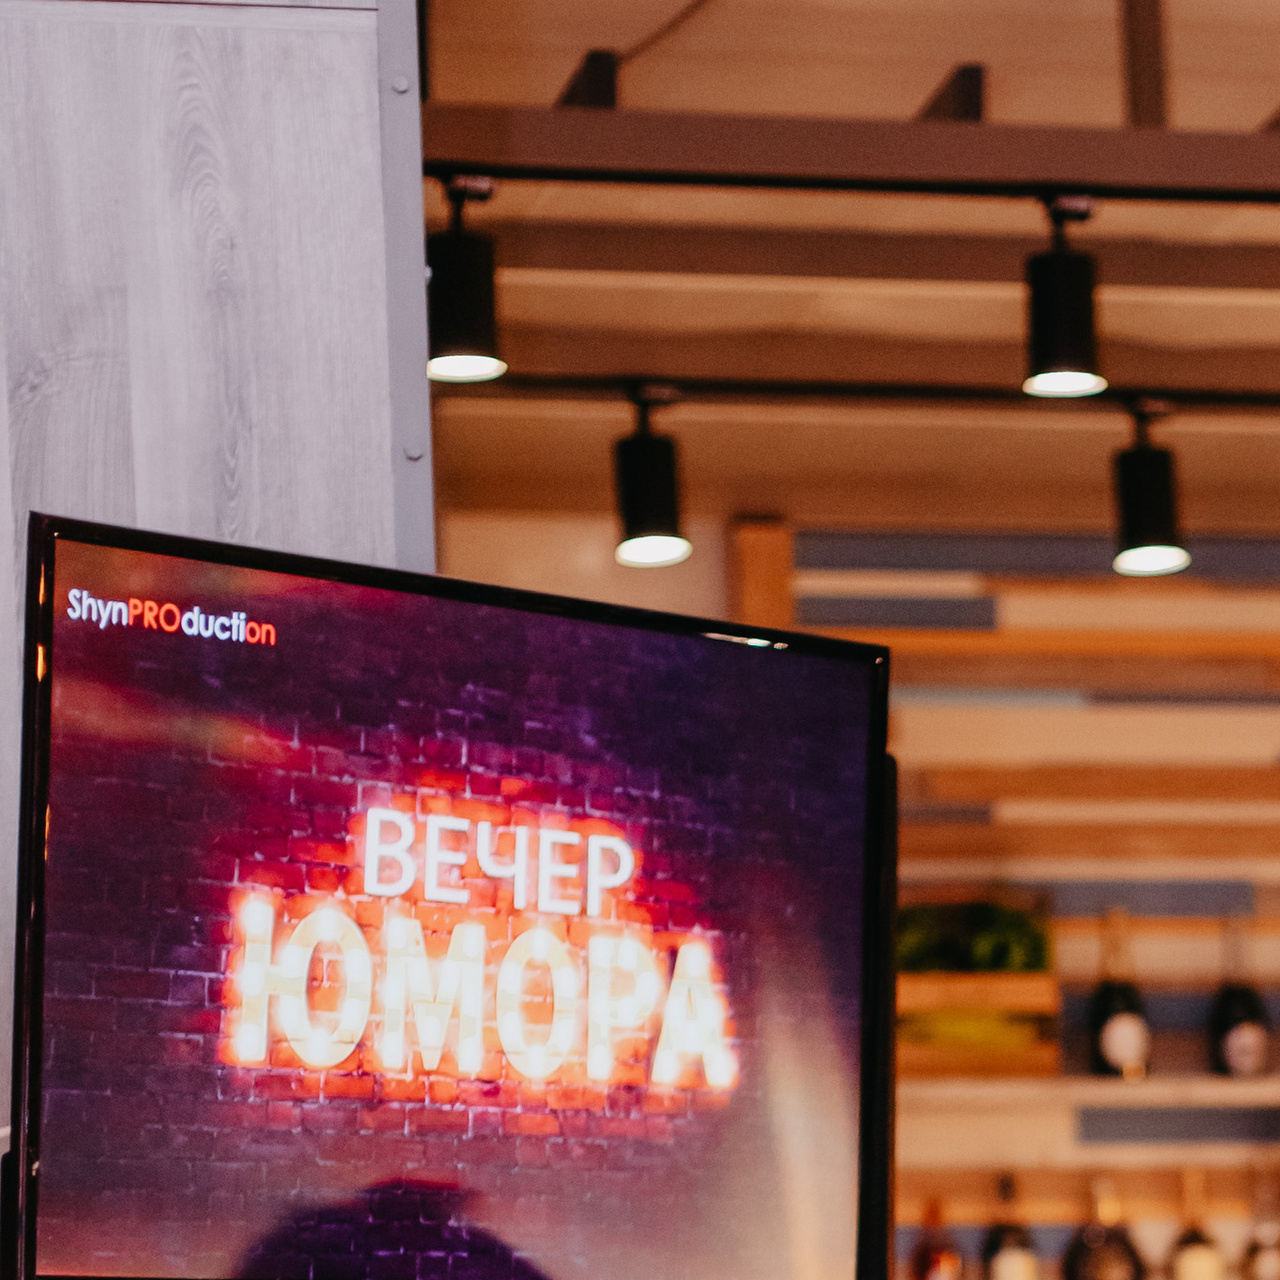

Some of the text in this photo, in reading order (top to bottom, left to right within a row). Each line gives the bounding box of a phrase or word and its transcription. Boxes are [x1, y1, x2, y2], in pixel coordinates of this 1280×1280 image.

[66, 587, 277, 646] ShynPROduction
[363, 807, 635, 917] ВЕЧЕР
[236, 899, 739, 1089] ЮМОРА
